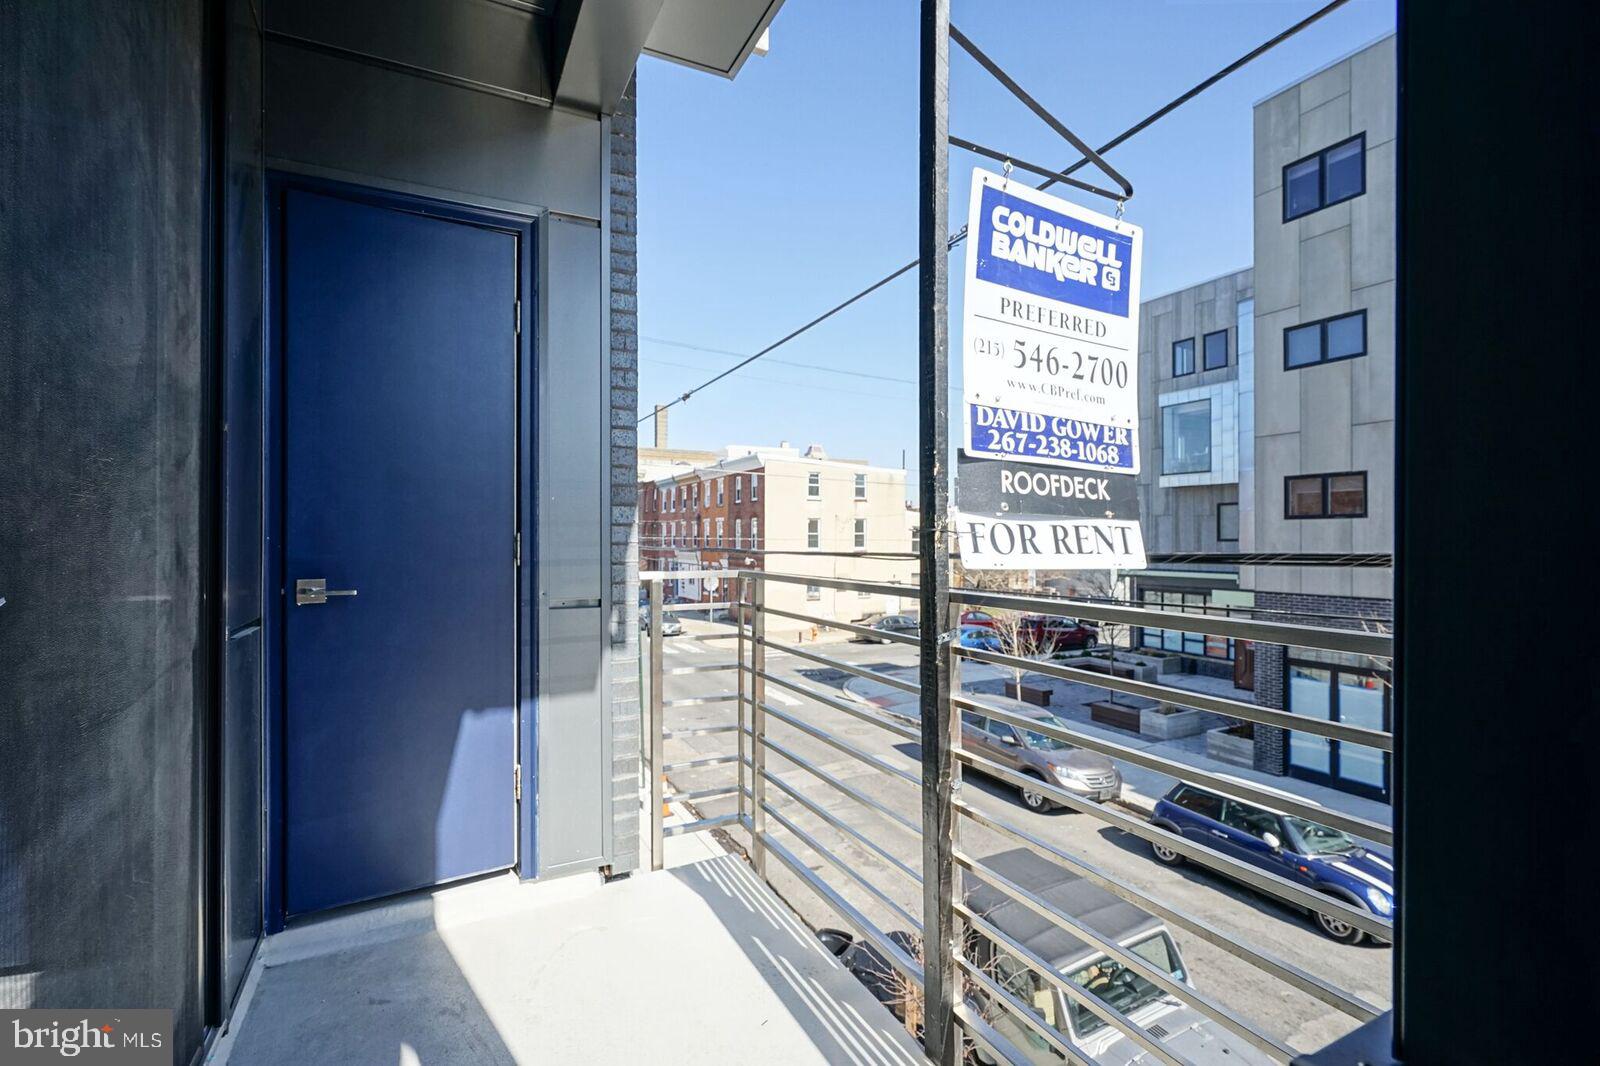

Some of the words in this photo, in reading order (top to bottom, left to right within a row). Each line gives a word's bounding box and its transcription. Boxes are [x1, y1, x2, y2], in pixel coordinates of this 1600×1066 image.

[1000, 297, 1107, 338] PREFERRED
[974, 337, 1005, 359] (215)
[1013, 339, 1128, 389] 546-2700
[976, 406, 1046, 433] DAVID
[1052, 417, 1129, 446] GOWER
[987, 430, 1119, 465] 267-238-1068
[1001, 470, 1111, 501] ROOFDECK
[966, 522, 1043, 555] FOR
[1048, 524, 1134, 556] RENT
